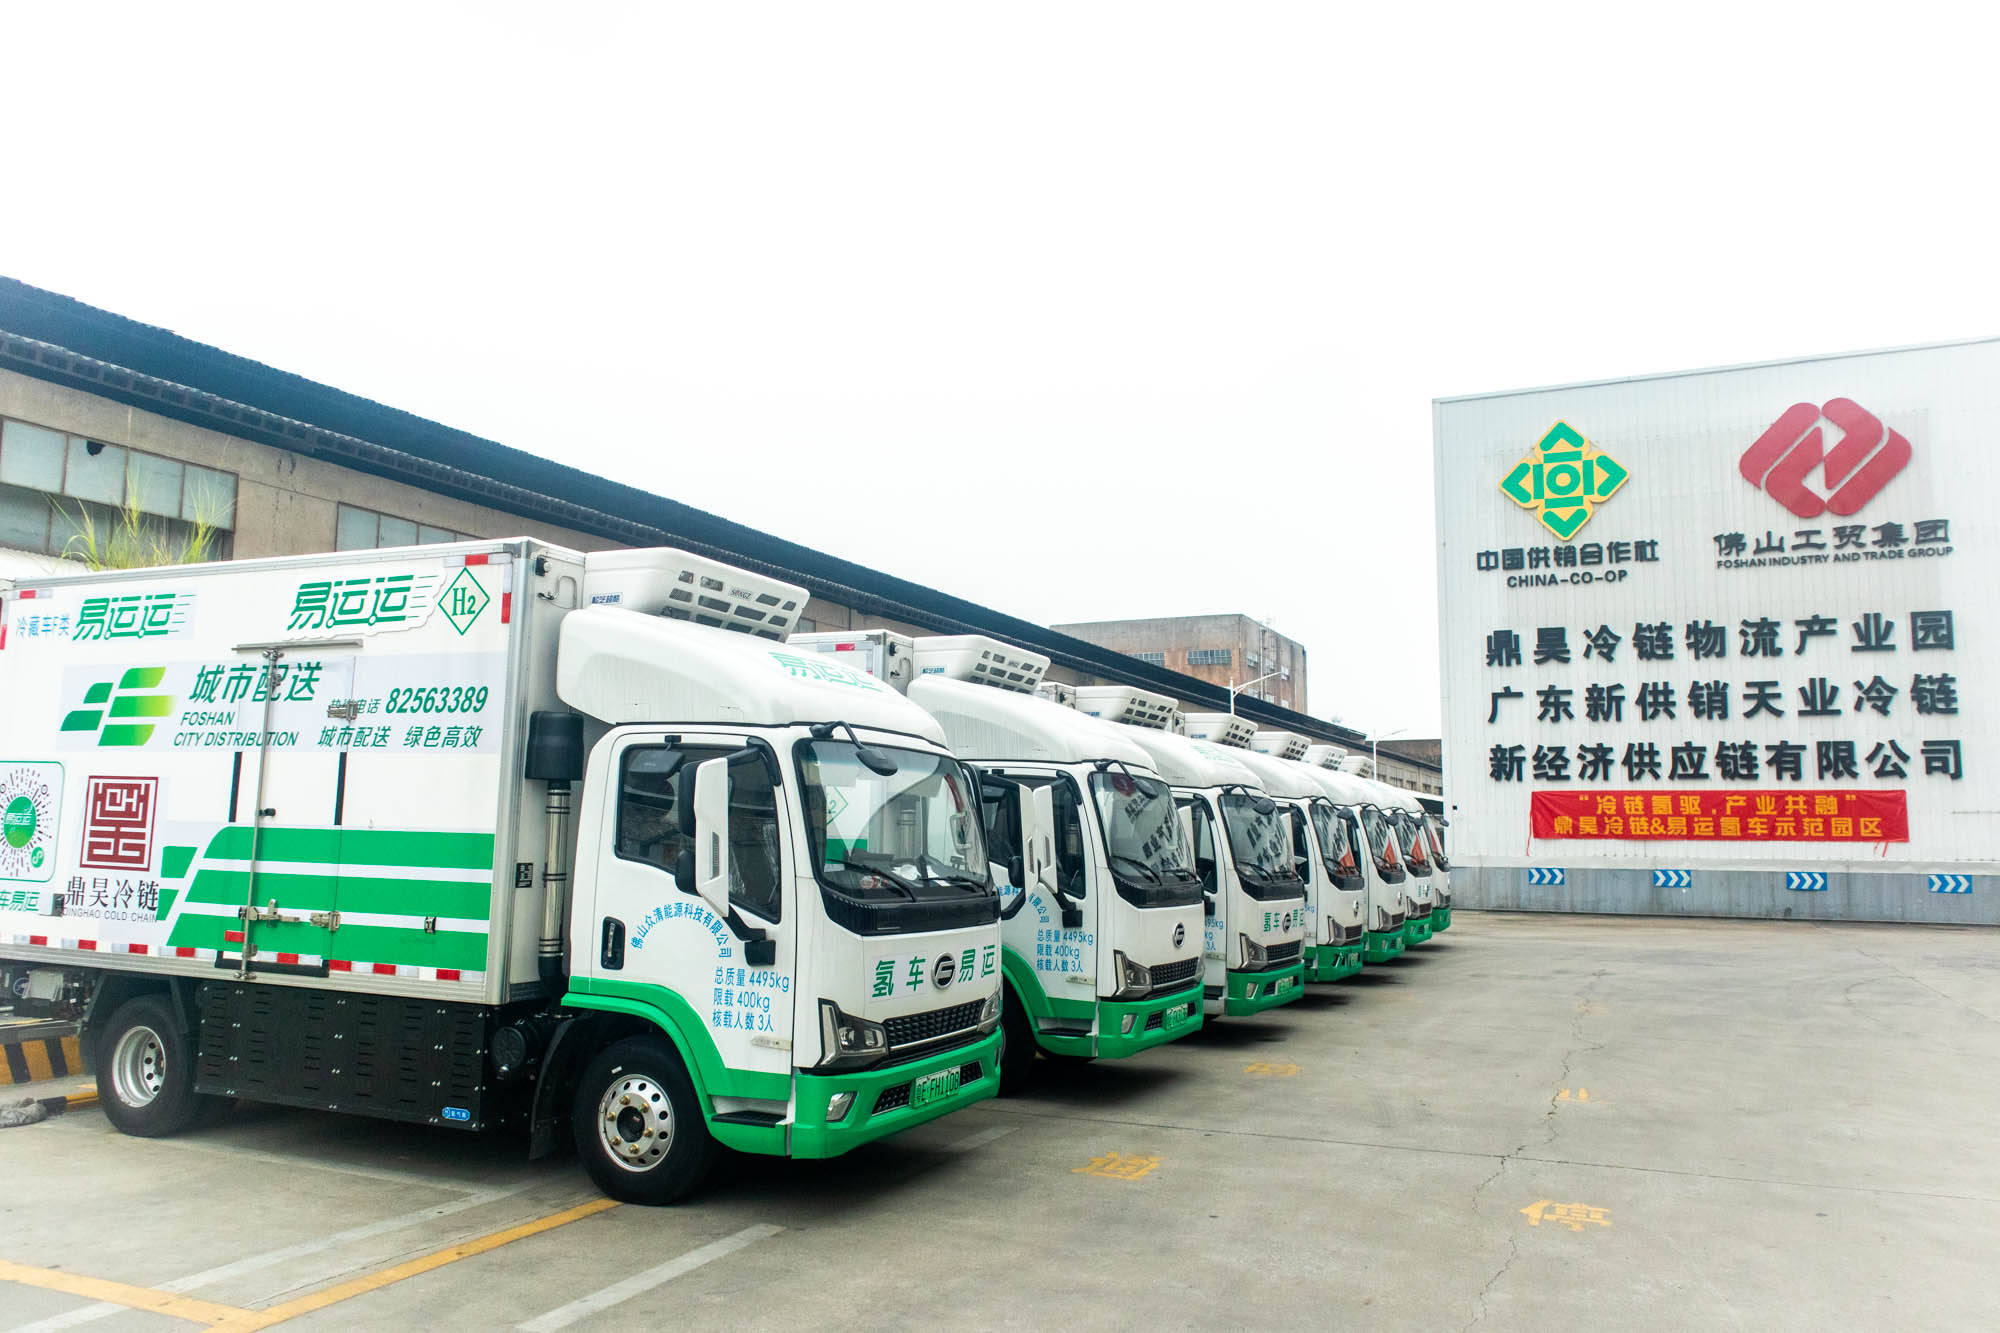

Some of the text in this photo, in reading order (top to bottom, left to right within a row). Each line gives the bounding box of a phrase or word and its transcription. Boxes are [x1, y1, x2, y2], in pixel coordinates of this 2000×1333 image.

[1713, 519, 1950, 557] 佛山工贸集团
[1476, 539, 1660, 571] 中国供销合作社
[1716, 546, 1954, 569] FOSHAN INDUSTRY AND TRADE GROUP
[1507, 569, 1628, 588] CHINA-CO-OP
[286, 574, 415, 632] 易运运
[72, 594, 177, 641] 易运运
[1486, 610, 1955, 667] 鼎昊冷链物流产业园
[188, 661, 323, 703] 城市配送
[385, 686, 489, 714] 82563389
[1487, 672, 1960, 724] 广东新供销天业冷链
[181, 711, 235, 726] FOSHAN
[174, 731, 299, 746] CITY DISTRIBUTION
[318, 725, 483, 748] 城市配送 绿色高效
[1488, 738, 1964, 782] 新经济供应链有限公司
[1554, 816, 1882, 836] 鼎昊冷链&易运氢车示范园区
[66, 876, 160, 912] 鼎昊冷链
[62, 909, 158, 923] DINGHAO COLD CHAIN
[631, 902, 732, 958] 佛山众清能源科技有限公司
[1037, 929, 1094, 946] 总质量 4495kg
[1036, 944, 1080, 960] 限载 400kg
[1036, 958, 1083, 972] 核载人数 3人
[714, 966, 790, 992] 总质量 4495kg
[872, 944, 995, 998] 氢车 易运
[714, 987, 770, 1012] 限载 400kg
[712, 1011, 774, 1032] 核载人数 3人
